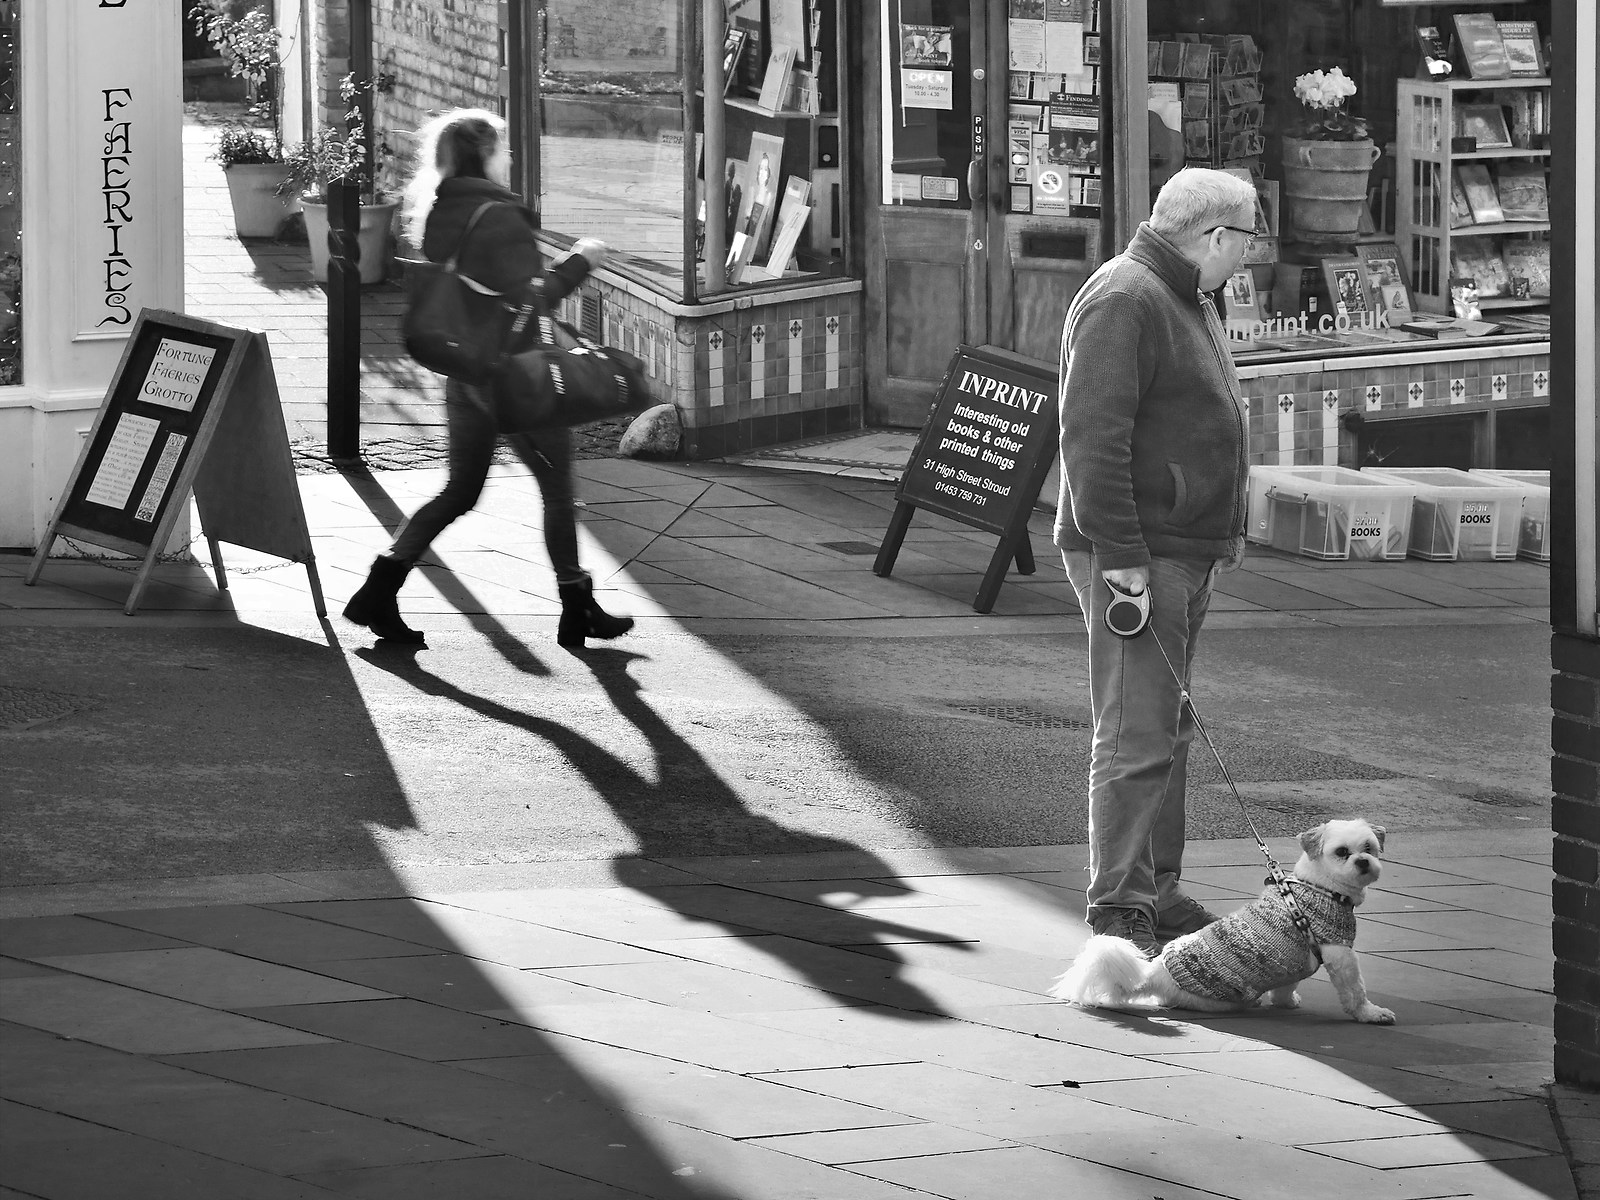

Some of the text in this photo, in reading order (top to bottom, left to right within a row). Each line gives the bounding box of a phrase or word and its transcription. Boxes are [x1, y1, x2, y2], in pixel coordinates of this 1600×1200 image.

[909, 72, 944, 84] OPEN
[928, 84, 948, 92] Saturday
[1065, 94, 1093, 103] FINDINGS
[95, 88, 134, 328] FAERIES
[157, 342, 213, 367] FORTUNE
[152, 362, 201, 385] FAERIES
[144, 380, 193, 404] GROTTO
[957, 370, 1048, 415] INPRINT
[953, 402, 1030, 437] Interesting old
[946, 418, 1023, 453] books & other
[939, 436, 1016, 471] printed things
[923, 458, 1011, 496] 31 High Street Stroud
[934, 481, 987, 506] 01453 759 731
[1460, 514, 1491, 524] BOOKS
[1351, 527, 1381, 537] BOOKS
